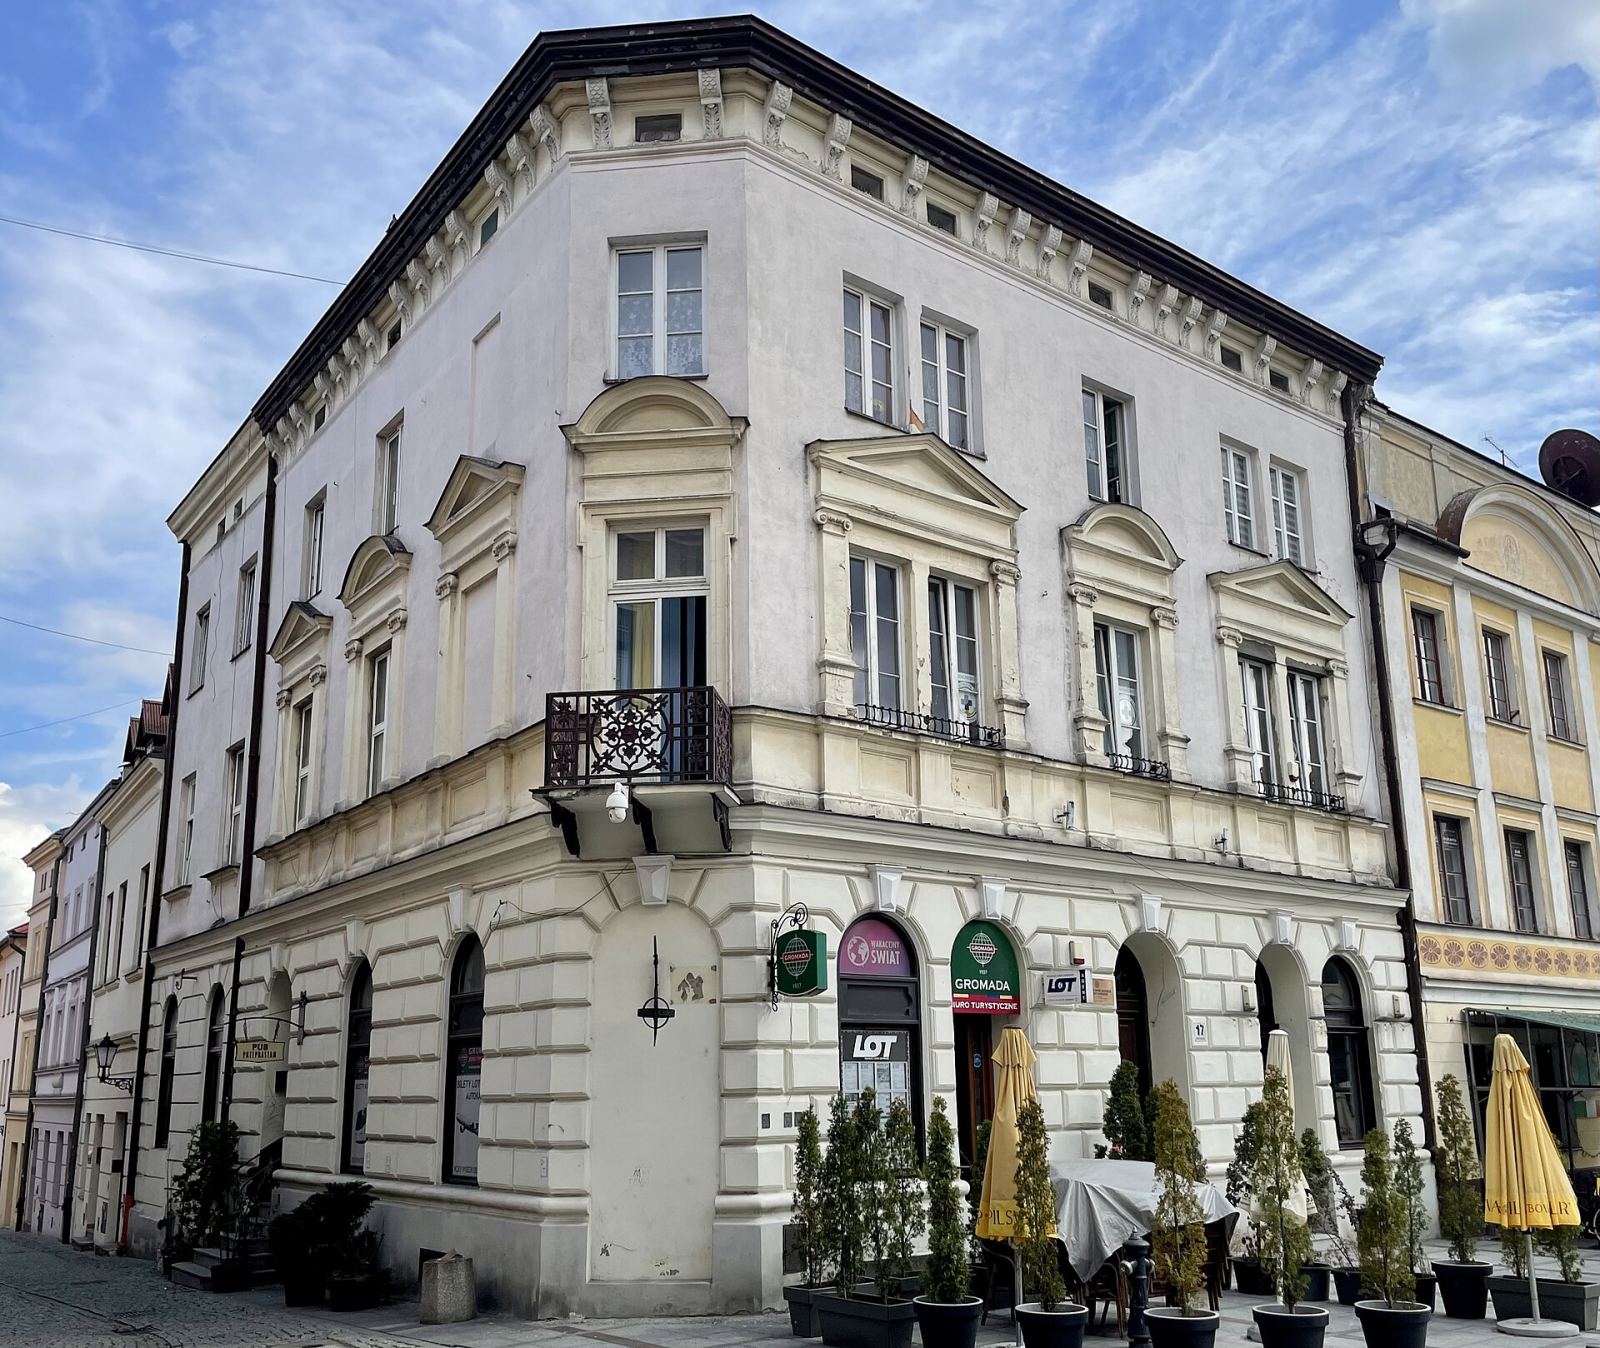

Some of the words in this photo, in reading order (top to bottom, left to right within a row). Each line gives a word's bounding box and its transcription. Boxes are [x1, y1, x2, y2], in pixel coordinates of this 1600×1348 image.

[784, 953, 809, 961] GROMADA
[955, 978, 1010, 992] GROMADA
[1047, 977, 1077, 993] LOT
[972, 1001, 1018, 1010] TURYSTYCZNE
[1195, 1024, 1204, 1036] 17
[852, 1035, 898, 1057] LOT
